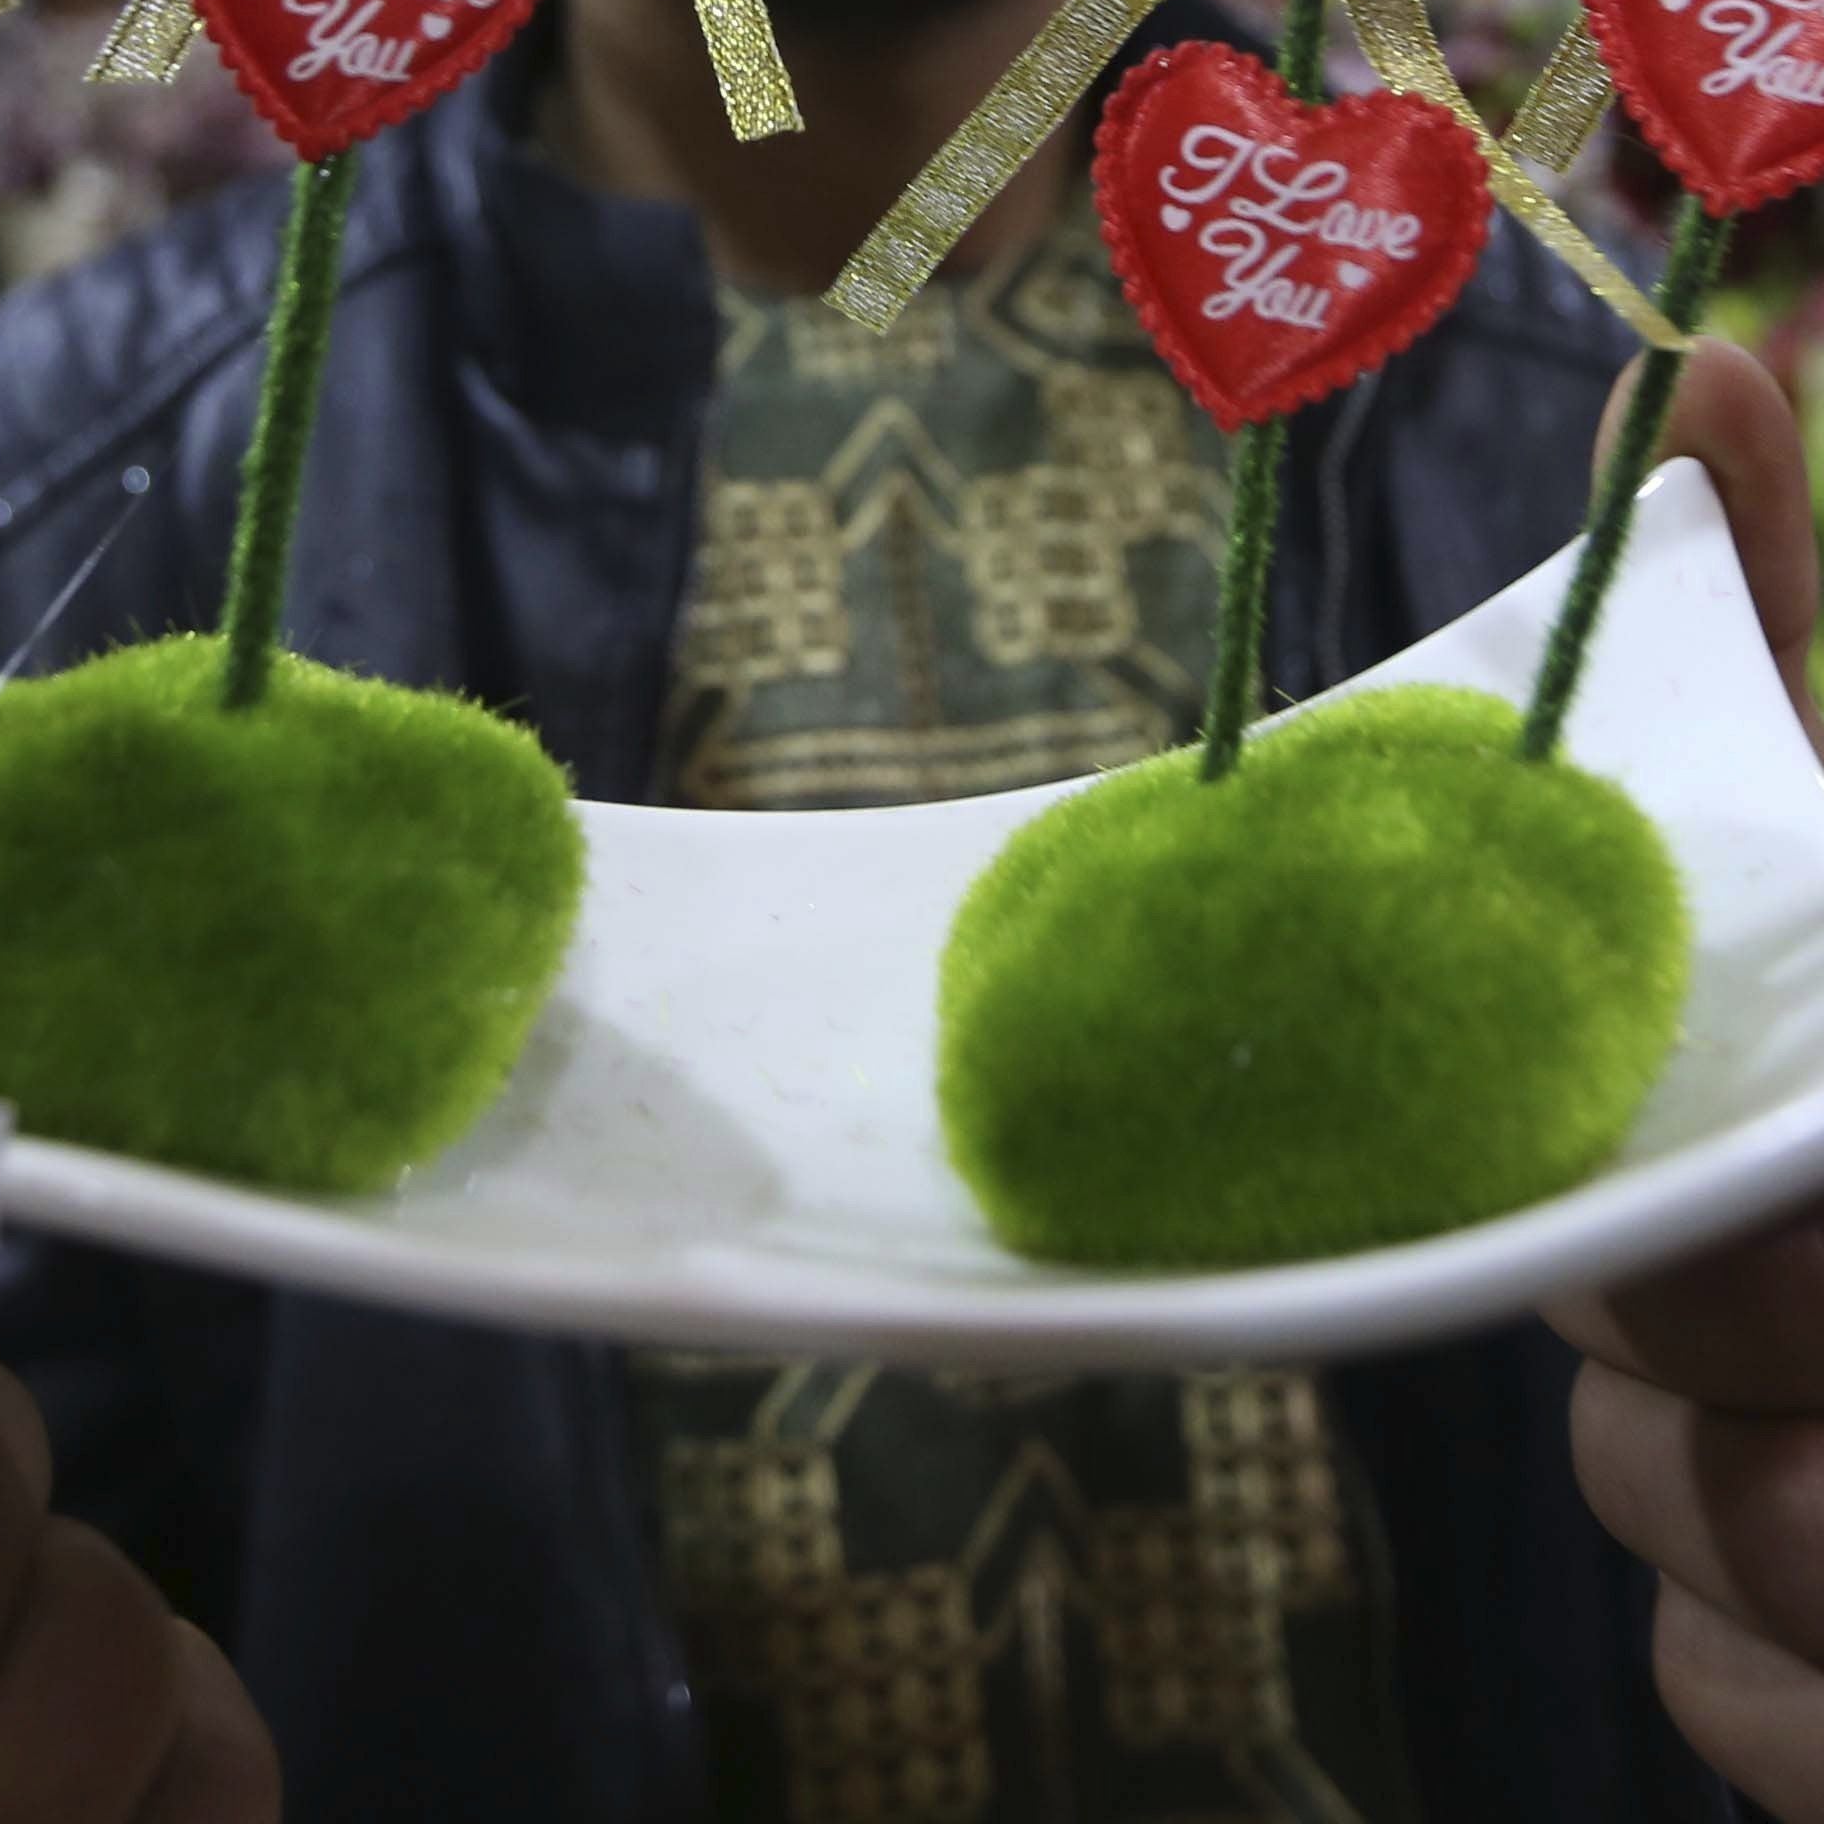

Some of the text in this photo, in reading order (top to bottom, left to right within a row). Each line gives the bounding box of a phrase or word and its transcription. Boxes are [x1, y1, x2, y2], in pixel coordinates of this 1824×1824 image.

[1158, 124, 1422, 261] I Love
[1197, 218, 1333, 330] You
